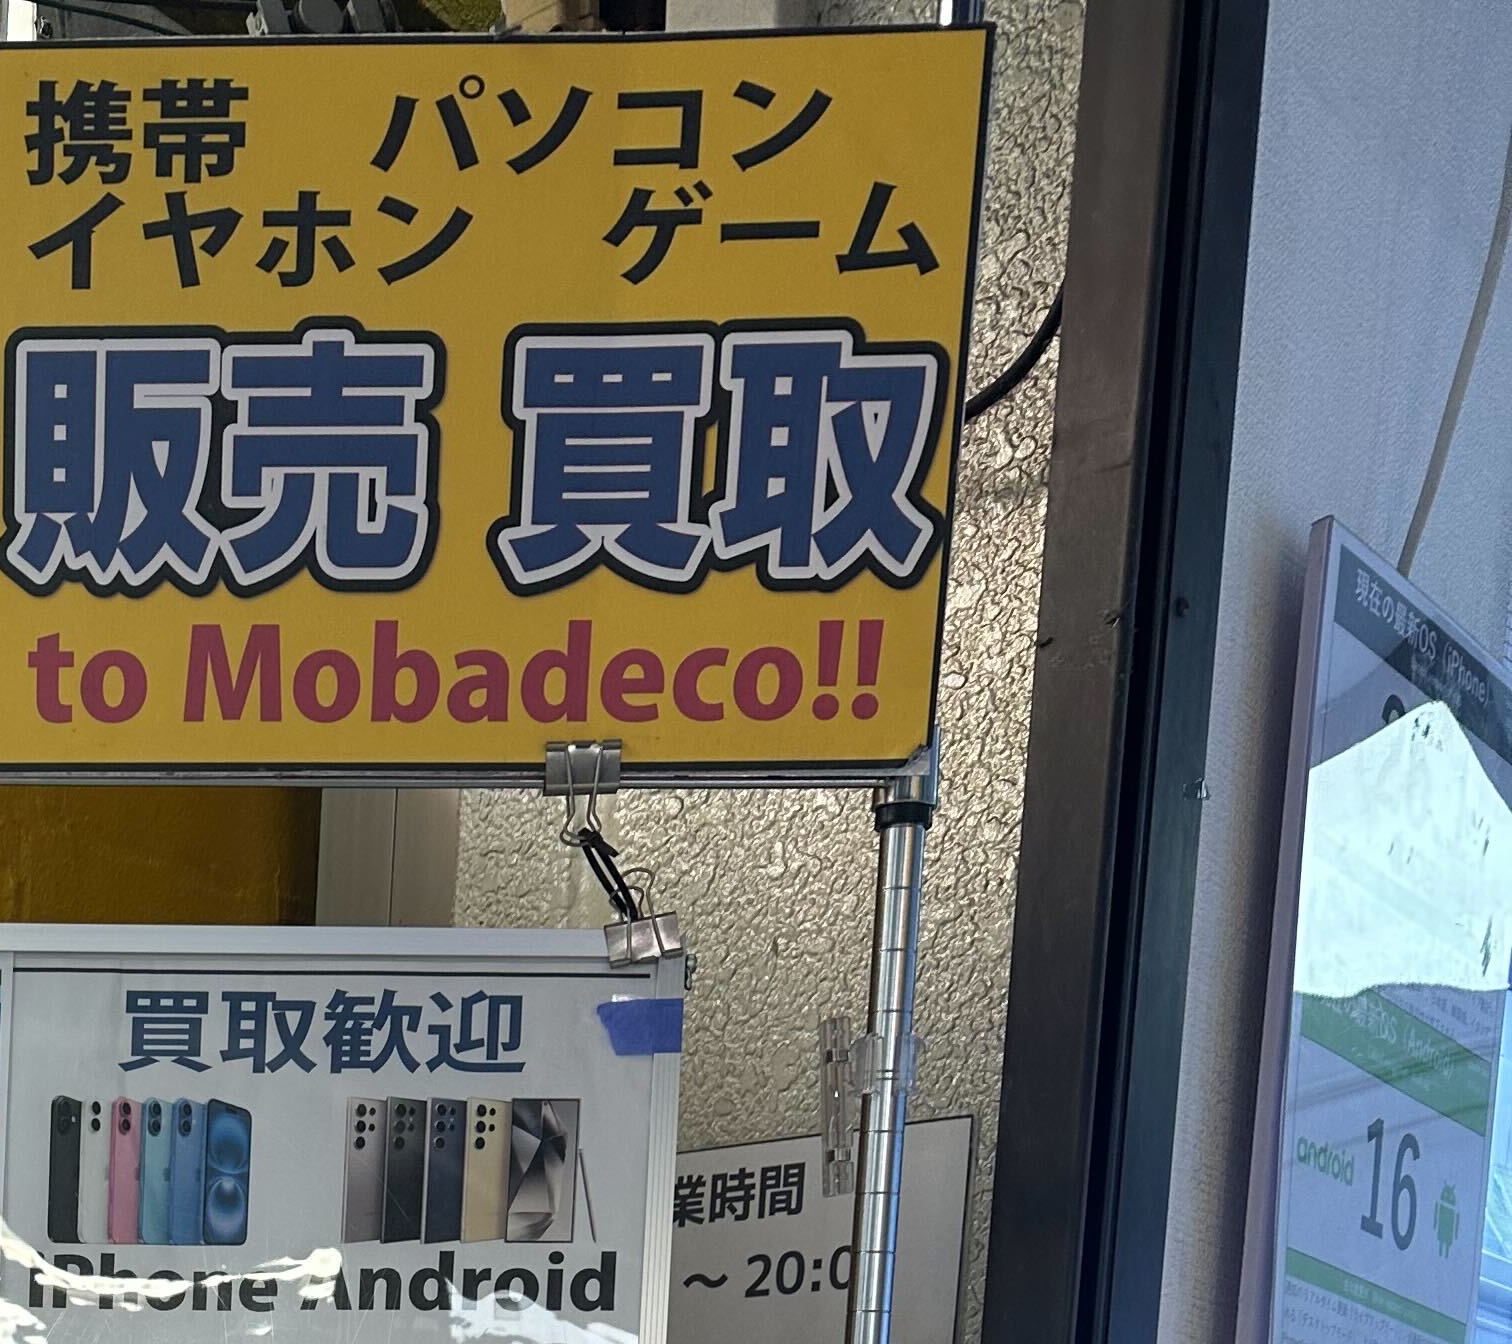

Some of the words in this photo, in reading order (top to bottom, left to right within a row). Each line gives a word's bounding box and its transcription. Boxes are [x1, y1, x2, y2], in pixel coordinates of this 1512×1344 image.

[24, 79, 247, 185] 携帯
[369, 75, 831, 175] パソコン
[28, 195, 473, 292] イヤホン
[603, 180, 939, 286] ゲーム
[488, 319, 948, 598] 買取
[27, 637, 145, 725] to
[184, 620, 883, 725] Mobadeco!!
[118, 989, 526, 1074] 買取歓迎
[1297, 1137, 1354, 1185] android
[1360, 1117, 1420, 1251] 16
[28, 1252, 278, 1312] iPhone
[300, 1251, 615, 1311] Android
[745, 1246, 853, 1297] 20:0
